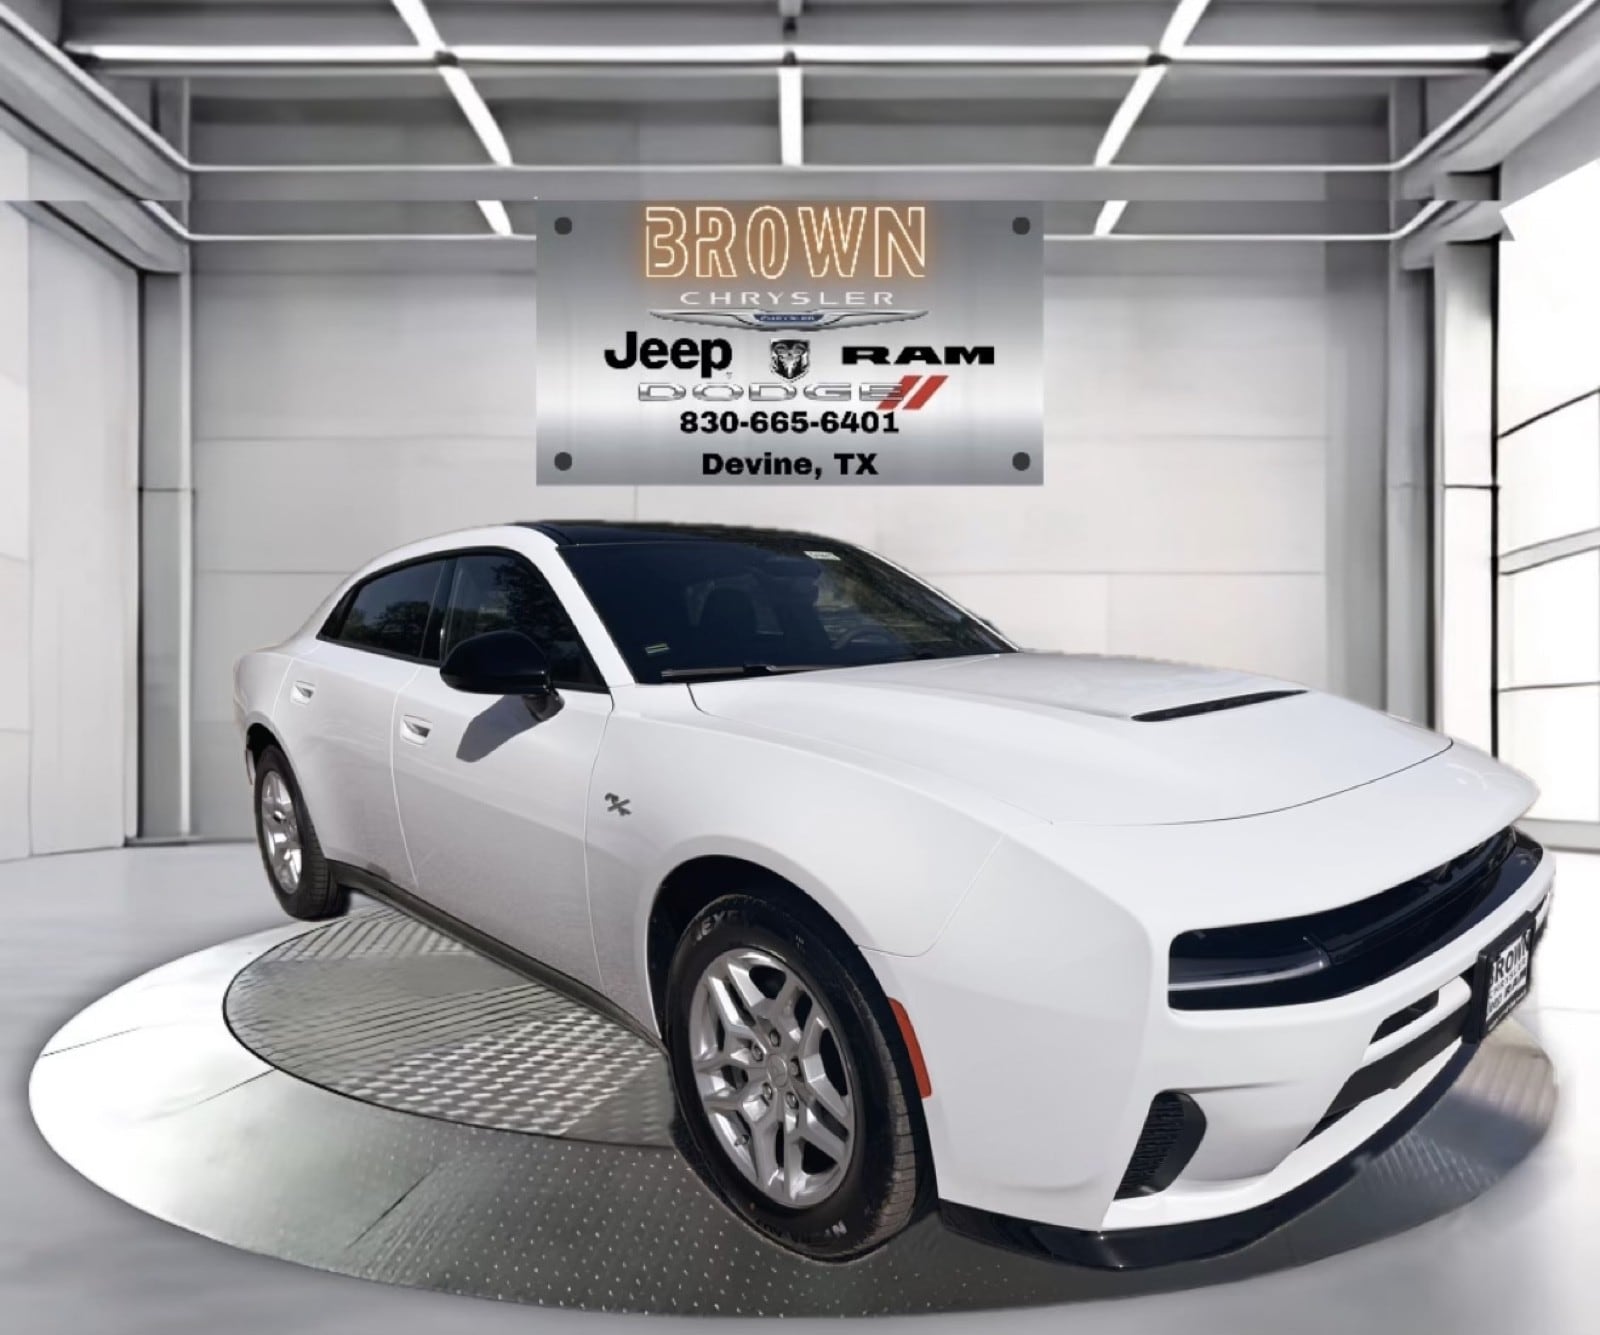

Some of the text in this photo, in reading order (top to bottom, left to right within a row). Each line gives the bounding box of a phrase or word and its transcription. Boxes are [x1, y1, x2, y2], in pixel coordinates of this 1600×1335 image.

[645, 205, 926, 280] BROWN
[679, 291, 894, 306] CHRYSLER
[603, 330, 733, 379] Jeep
[841, 345, 996, 366] RAM
[637, 382, 905, 402] DODGE
[679, 410, 901, 434] 830-665-6401
[701, 451, 880, 481] Devine, TX
